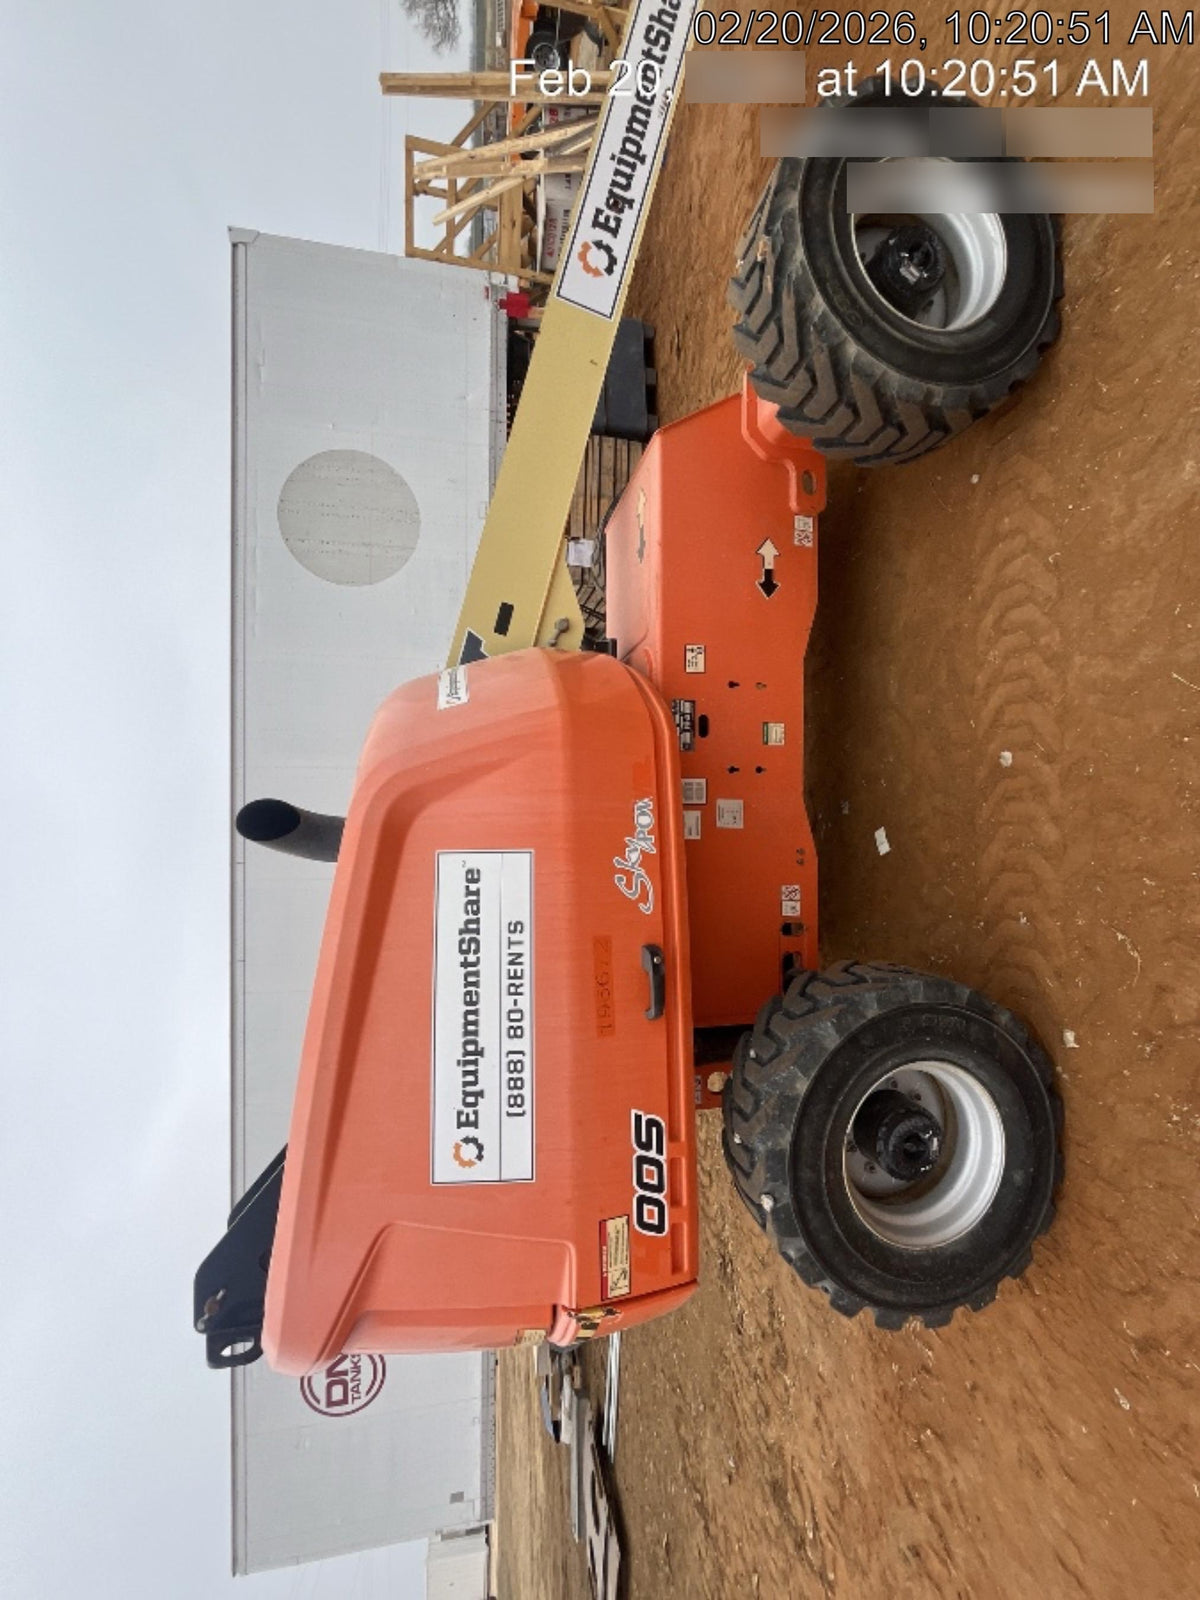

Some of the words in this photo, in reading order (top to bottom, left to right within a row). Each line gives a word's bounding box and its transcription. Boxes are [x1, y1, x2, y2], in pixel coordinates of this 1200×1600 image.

[456, 868, 484, 1129] EquipmentShare
[506, 920, 525, 1040] 80-RENTS
[506, 1050, 525, 1118] (888)
